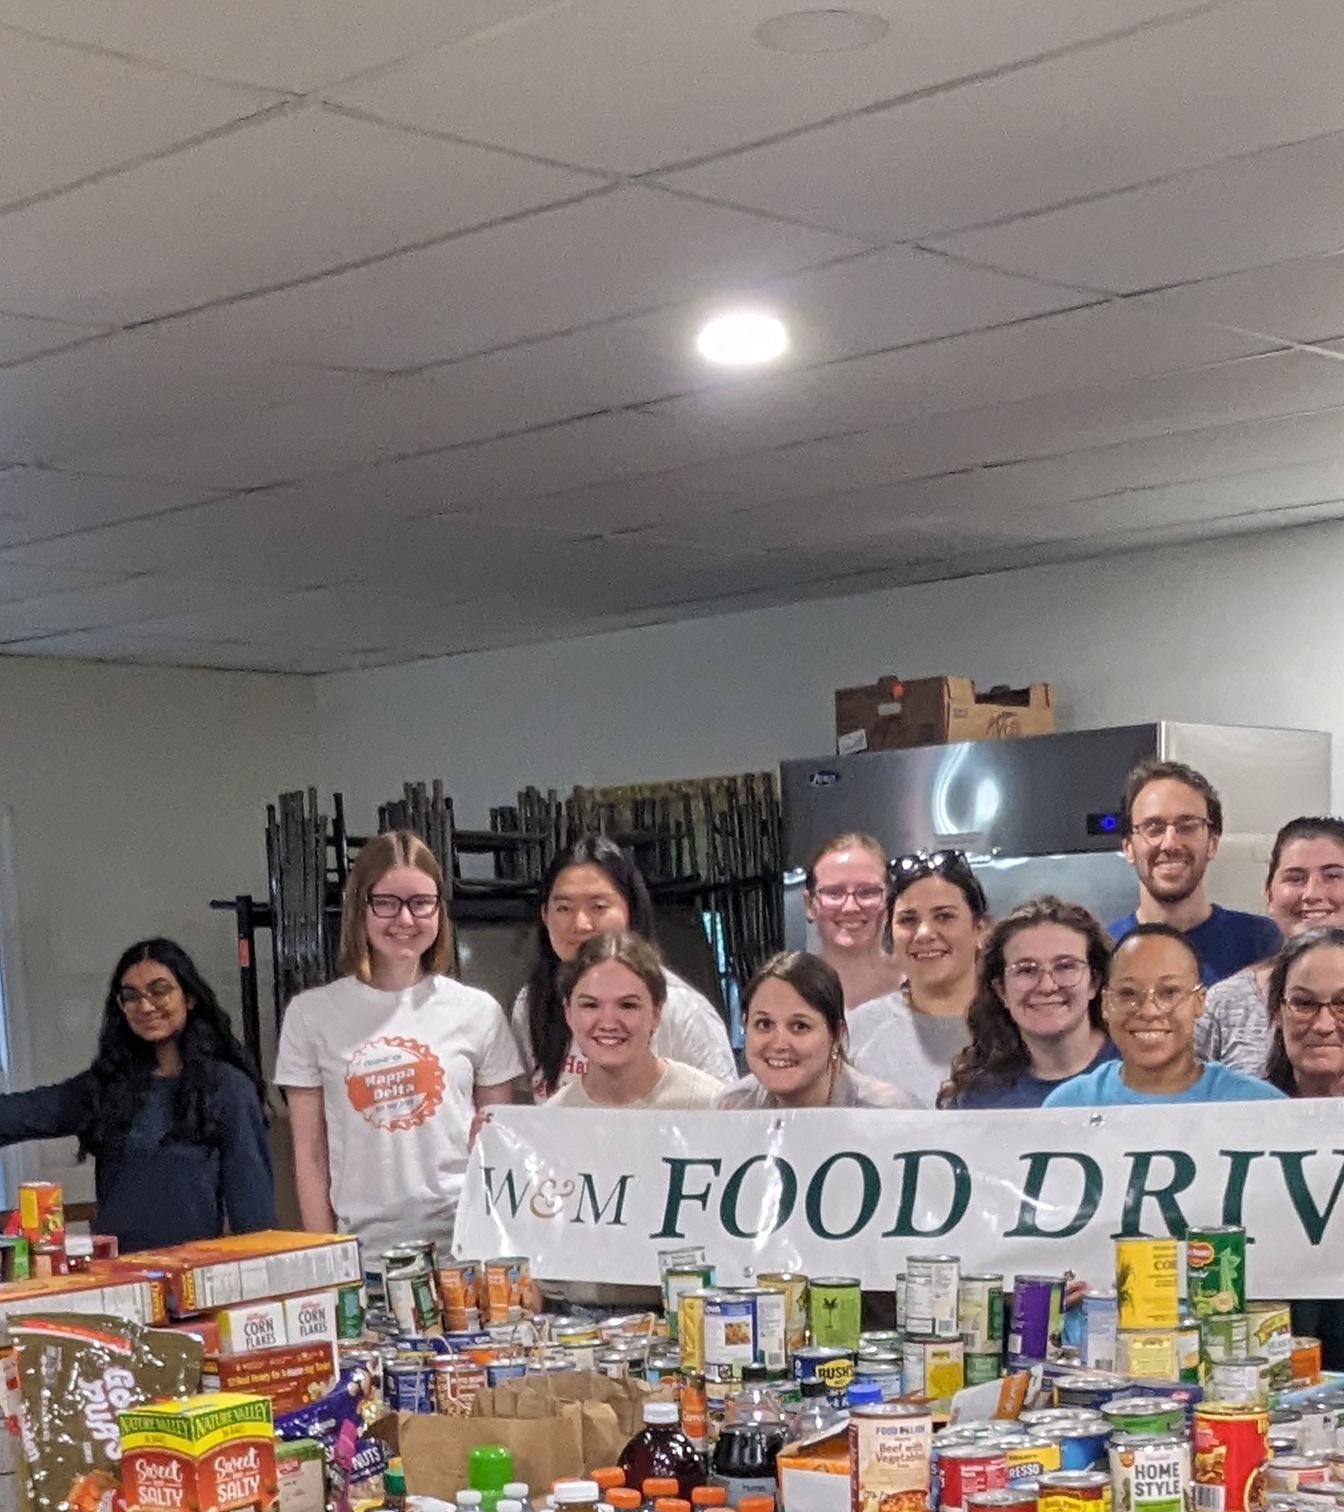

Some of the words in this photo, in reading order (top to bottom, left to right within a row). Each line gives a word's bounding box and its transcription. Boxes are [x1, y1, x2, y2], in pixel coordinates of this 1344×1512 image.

[373, 1084, 416, 1101] Delta
[479, 1166, 635, 1226] W&M
[649, 1149, 971, 1242] FOOD
[298, 1308, 326, 1325] CORN
[243, 1319, 274, 1337] CORN
[299, 1322, 327, 1337] FLAKES
[245, 1334, 276, 1350] FLAKES
[120, 1414, 156, 1434] NATURE
[156, 1416, 195, 1442] VALLEY
[195, 1408, 234, 1438] NATURE
[234, 1401, 271, 1422] VALLEY
[879, 1443, 903, 1454] Beef
[906, 1443, 923, 1453] with
[214, 1447, 260, 1475] Sweet
[351, 1447, 382, 1471] NUTS
[135, 1459, 183, 1483] Sweet
[1134, 1462, 1181, 1480] HOME
[138, 1486, 184, 1508] SALTY
[217, 1474, 260, 1502] SALTY
[1134, 1480, 1181, 1497] STYLE
